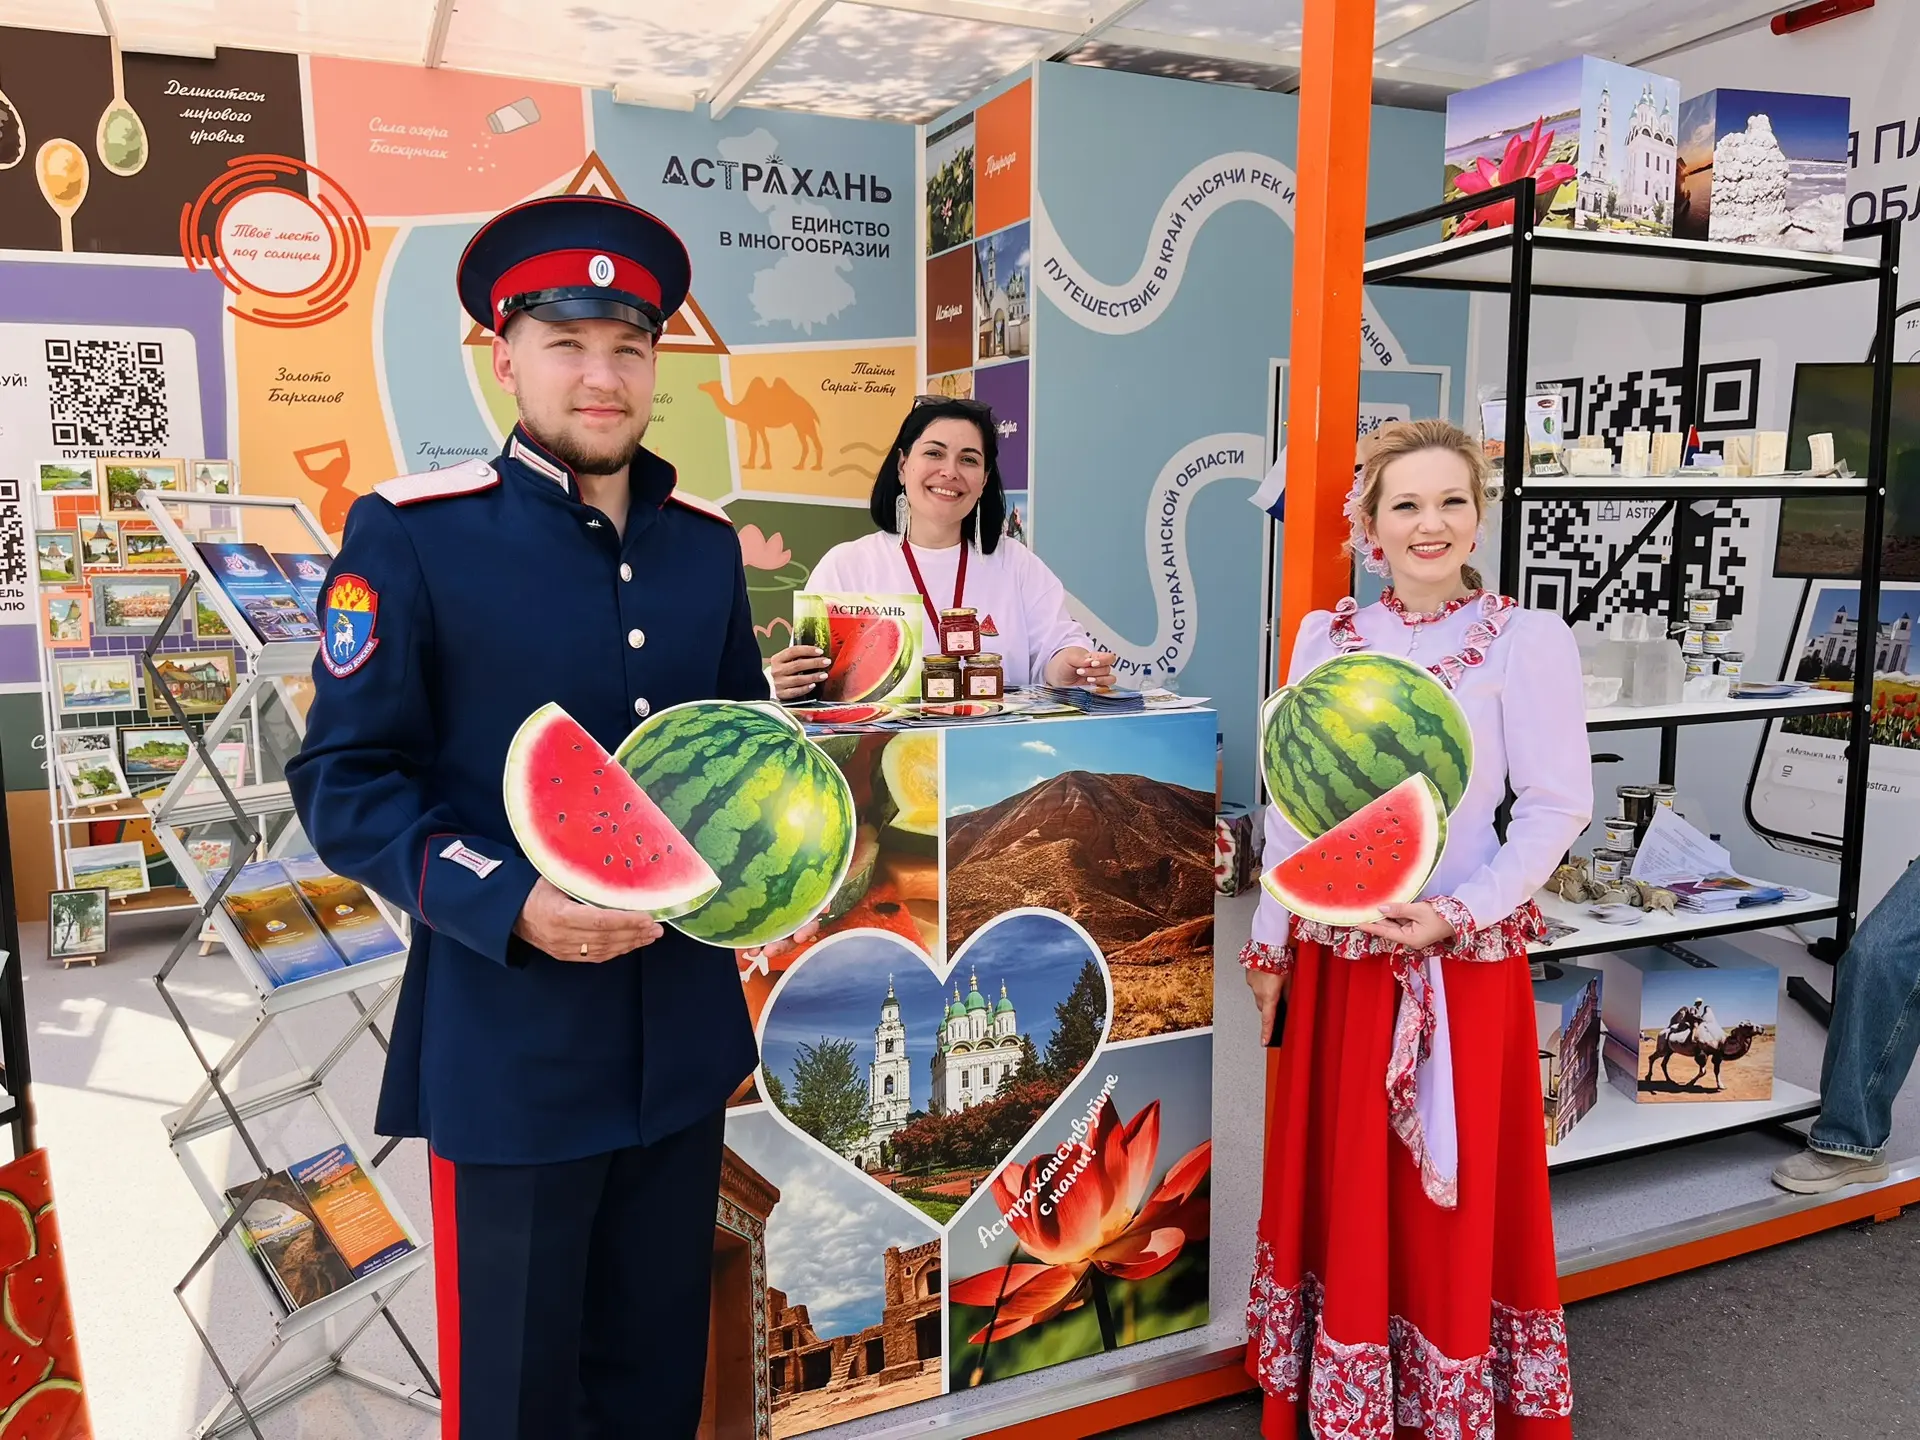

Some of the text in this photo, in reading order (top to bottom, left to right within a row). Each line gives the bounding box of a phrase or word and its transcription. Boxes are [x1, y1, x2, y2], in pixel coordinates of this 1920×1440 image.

[163, 79, 266, 102] Деликатесы
[179, 107, 252, 124] мирового
[189, 129, 245, 145] уровня
[369, 116, 449, 141] Сила озера
[368, 138, 449, 160] Баскунчак
[661, 154, 892, 203] АСТРАХАНЬ
[1250, 169, 1282, 194] РЕК
[1181, 168, 1246, 213] ТЫСЯЧИ
[1282, 187, 1295, 204] И
[230, 223, 320, 242] Твоё место
[791, 216, 890, 238] ЕДИНСТВО
[1159, 211, 1187, 264] КРАЙ
[232, 248, 321, 262] под солнцем
[719, 231, 890, 259] В МНОГООБРАЗИИ
[1154, 265, 1168, 281] В
[1043, 257, 1160, 318] ПУТЕШЕСТВИЕ
[0, 372, 28, 387] УЙ!
[274, 366, 331, 384] Золото
[851, 362, 896, 377] Тайны
[267, 388, 345, 406] Барханов
[820, 378, 896, 396] Сарай-Бату
[62, 448, 161, 459] ПУТЕШЕСТВУЙ
[416, 441, 489, 459] Гармония
[1175, 450, 1244, 487] ОБЛАСТИ
[1160, 489, 1187, 644] АСТРАХАНСКОЙ
[830, 604, 906, 617] АСТРАХАНЬ
[1156, 645, 1179, 671] ПО
[977, 1073, 1119, 1249] Астраханствуйте
[1039, 1141, 1097, 1217] с нами!
